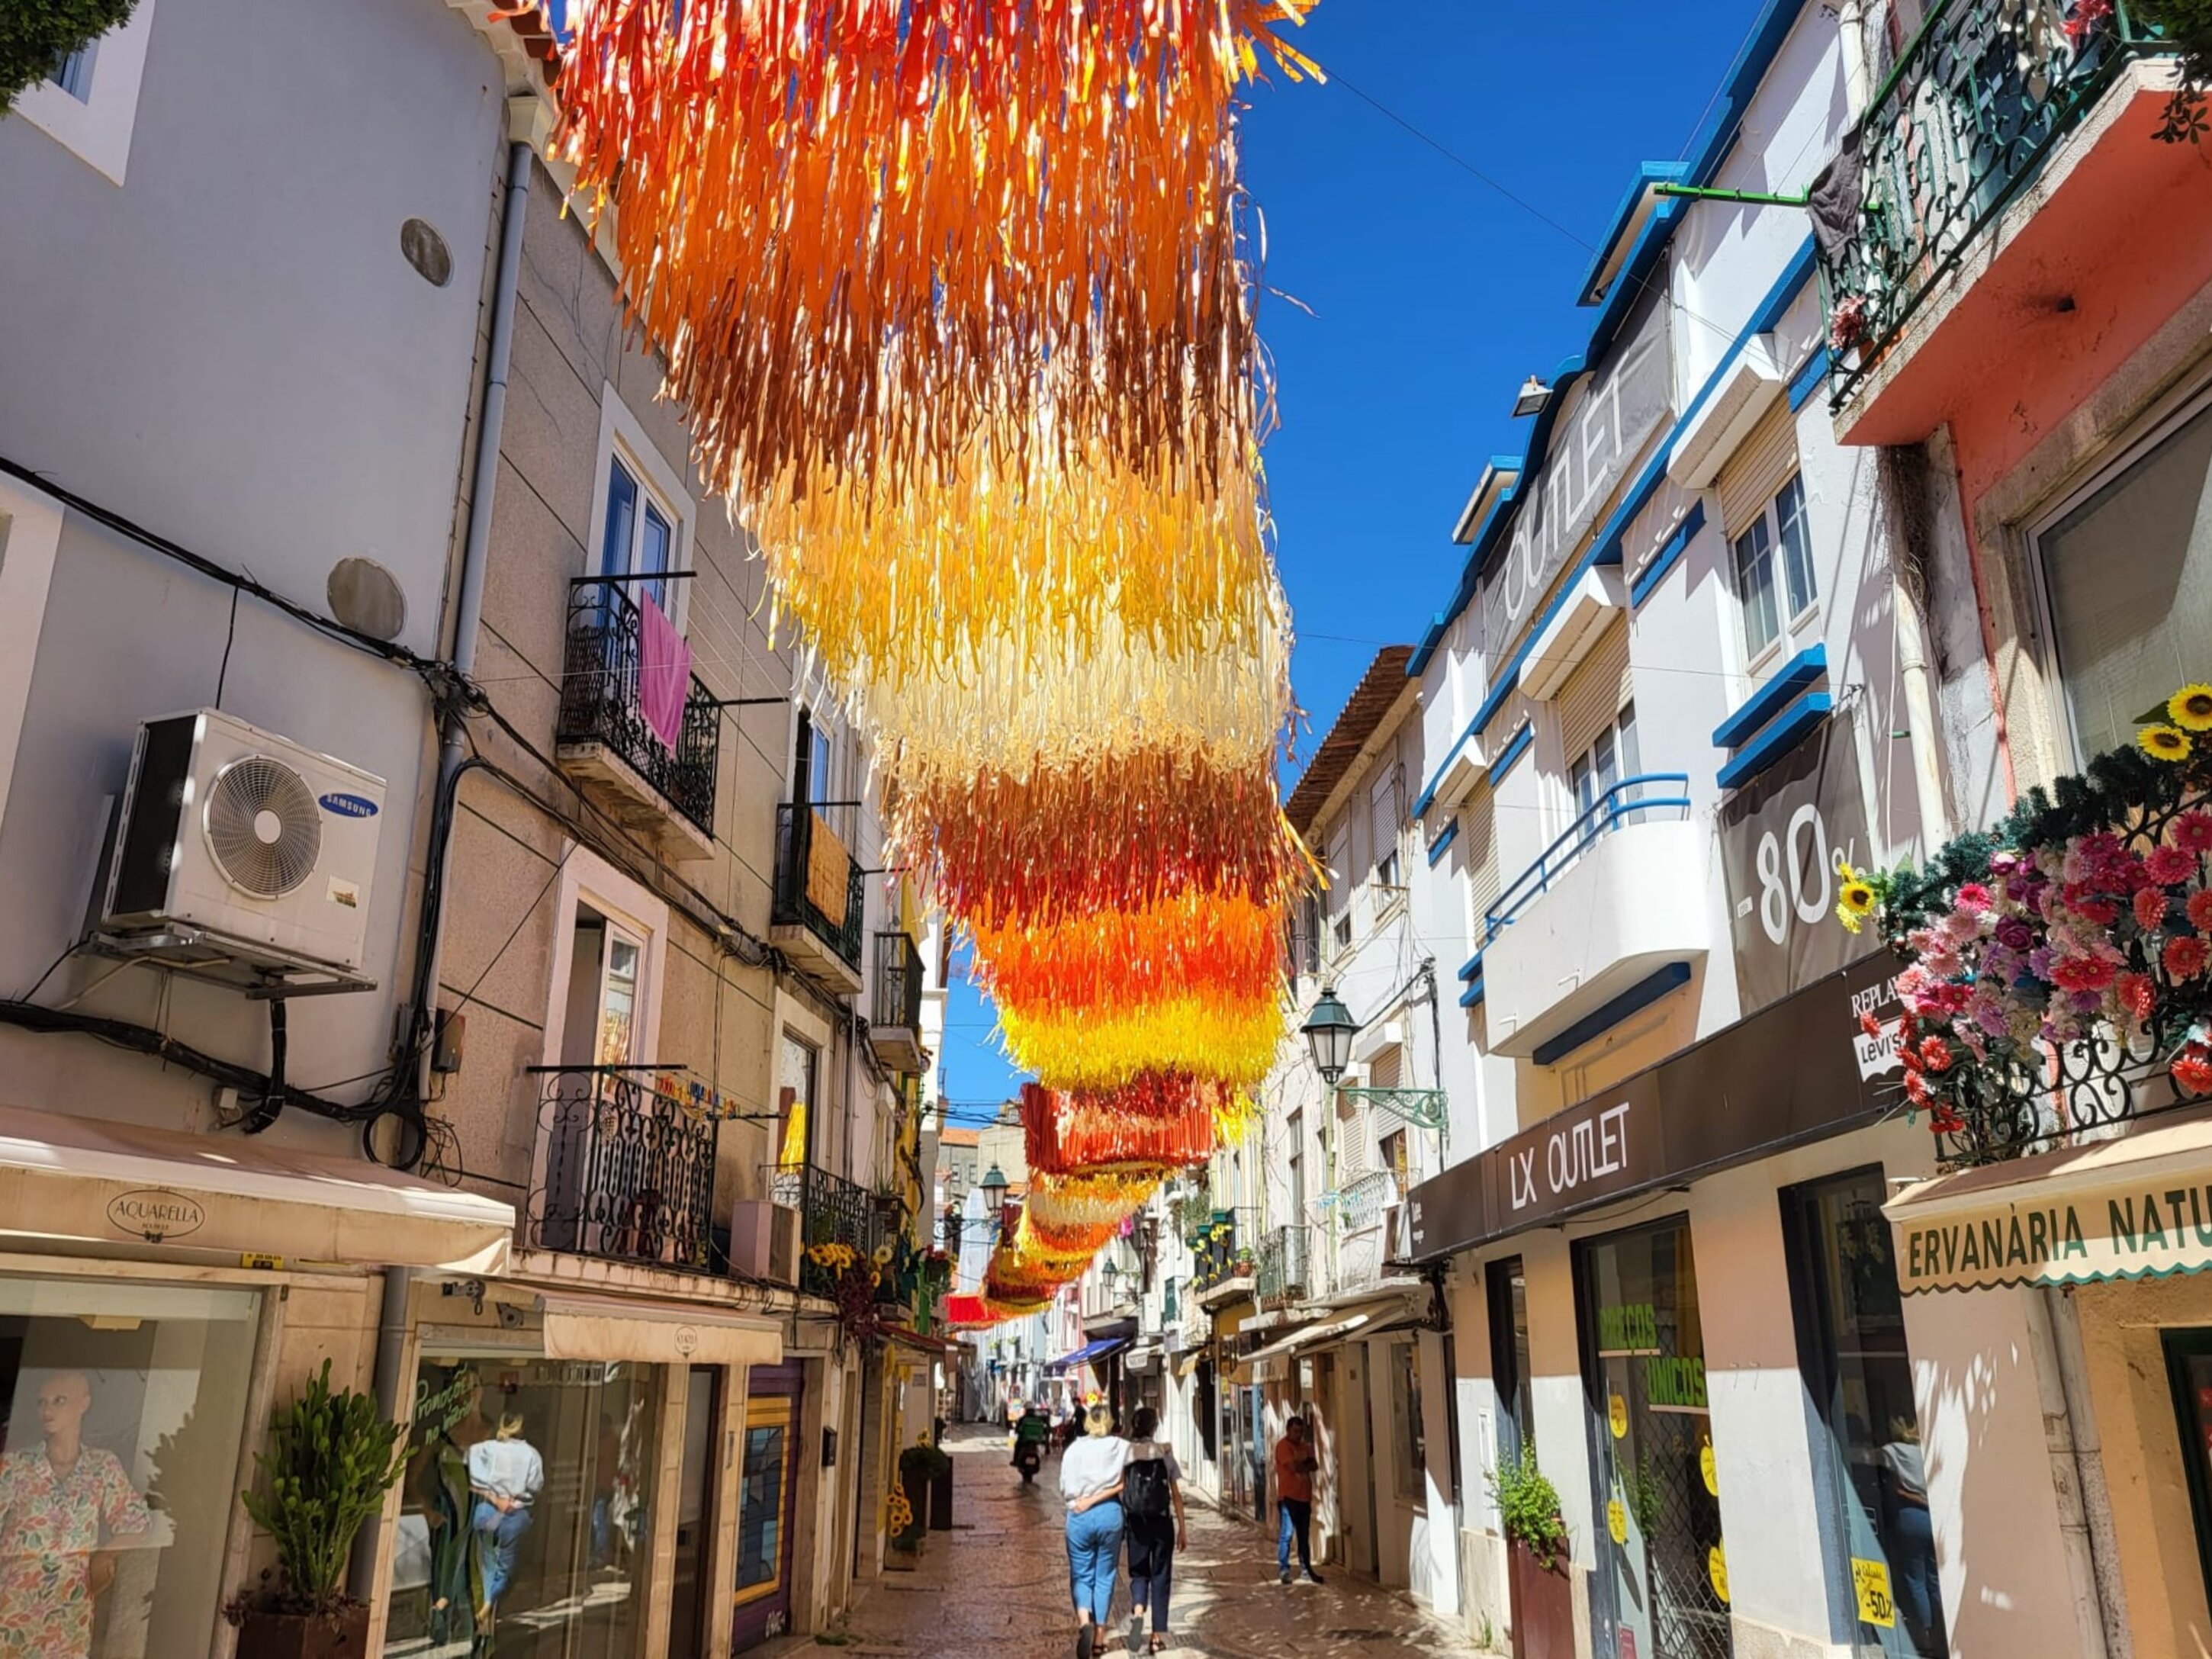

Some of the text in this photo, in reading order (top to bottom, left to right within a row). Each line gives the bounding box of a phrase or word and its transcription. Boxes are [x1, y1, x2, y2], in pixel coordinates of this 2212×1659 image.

[1504, 351, 1629, 621] OUTLET
[326, 794, 371, 817] SAMSUNG
[1510, 1101, 1629, 1210] LX OUTLET
[115, 1201, 198, 1223] AQUARELLA
